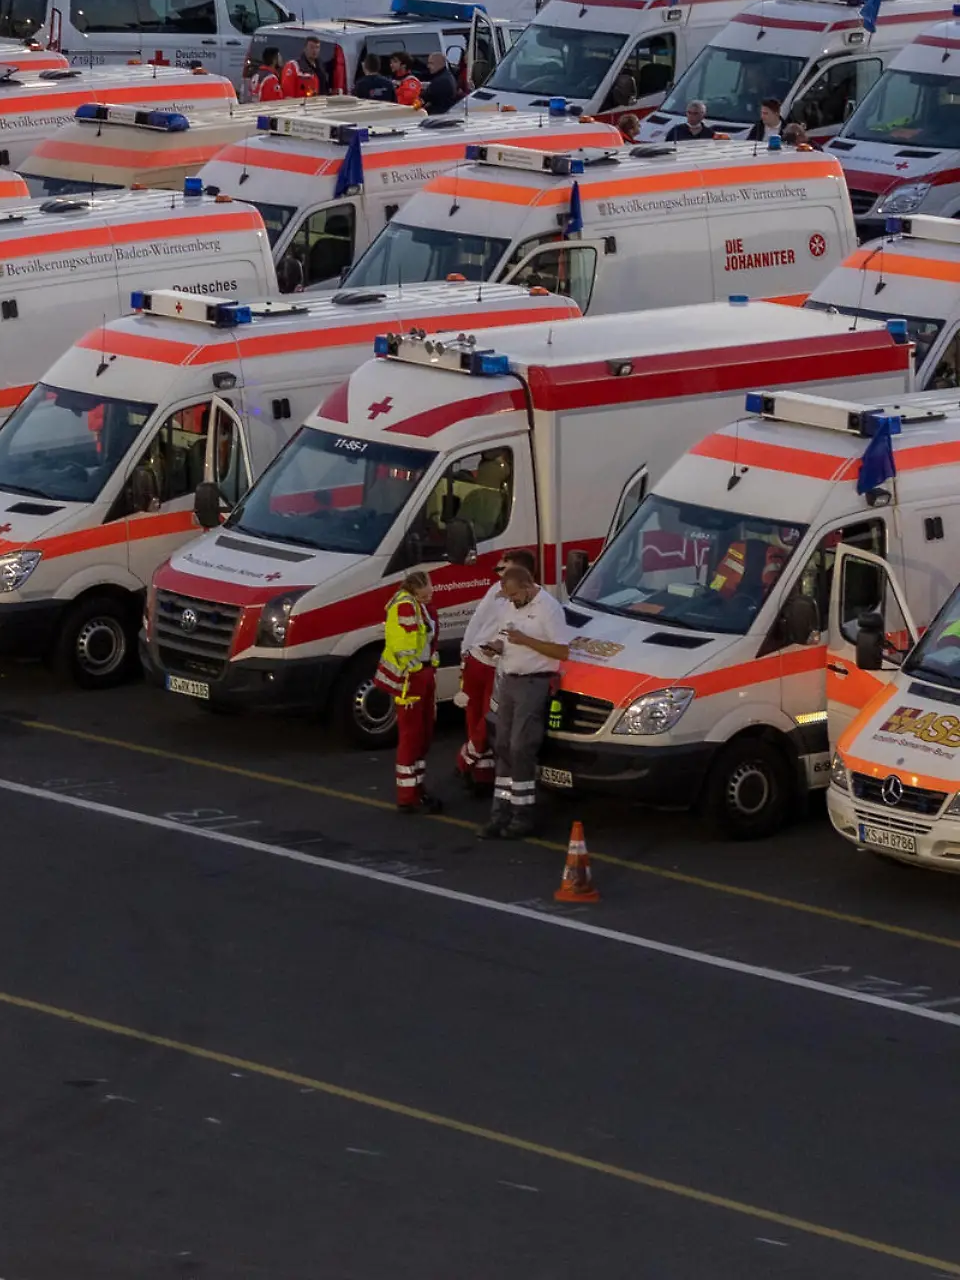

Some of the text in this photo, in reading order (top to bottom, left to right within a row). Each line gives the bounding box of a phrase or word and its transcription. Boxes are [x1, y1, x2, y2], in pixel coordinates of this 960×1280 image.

[175, 49, 217, 60] Deutsches
[606, 185, 807, 216] Bevölkerungsschutz Baden-Württemberg
[724, 238, 743, 254] DIE
[6, 238, 221, 277] Bevölkerungsschutz Baden-Württemberg
[724, 249, 795, 271] JOHANNITER
[864, 828, 878, 842] KS
